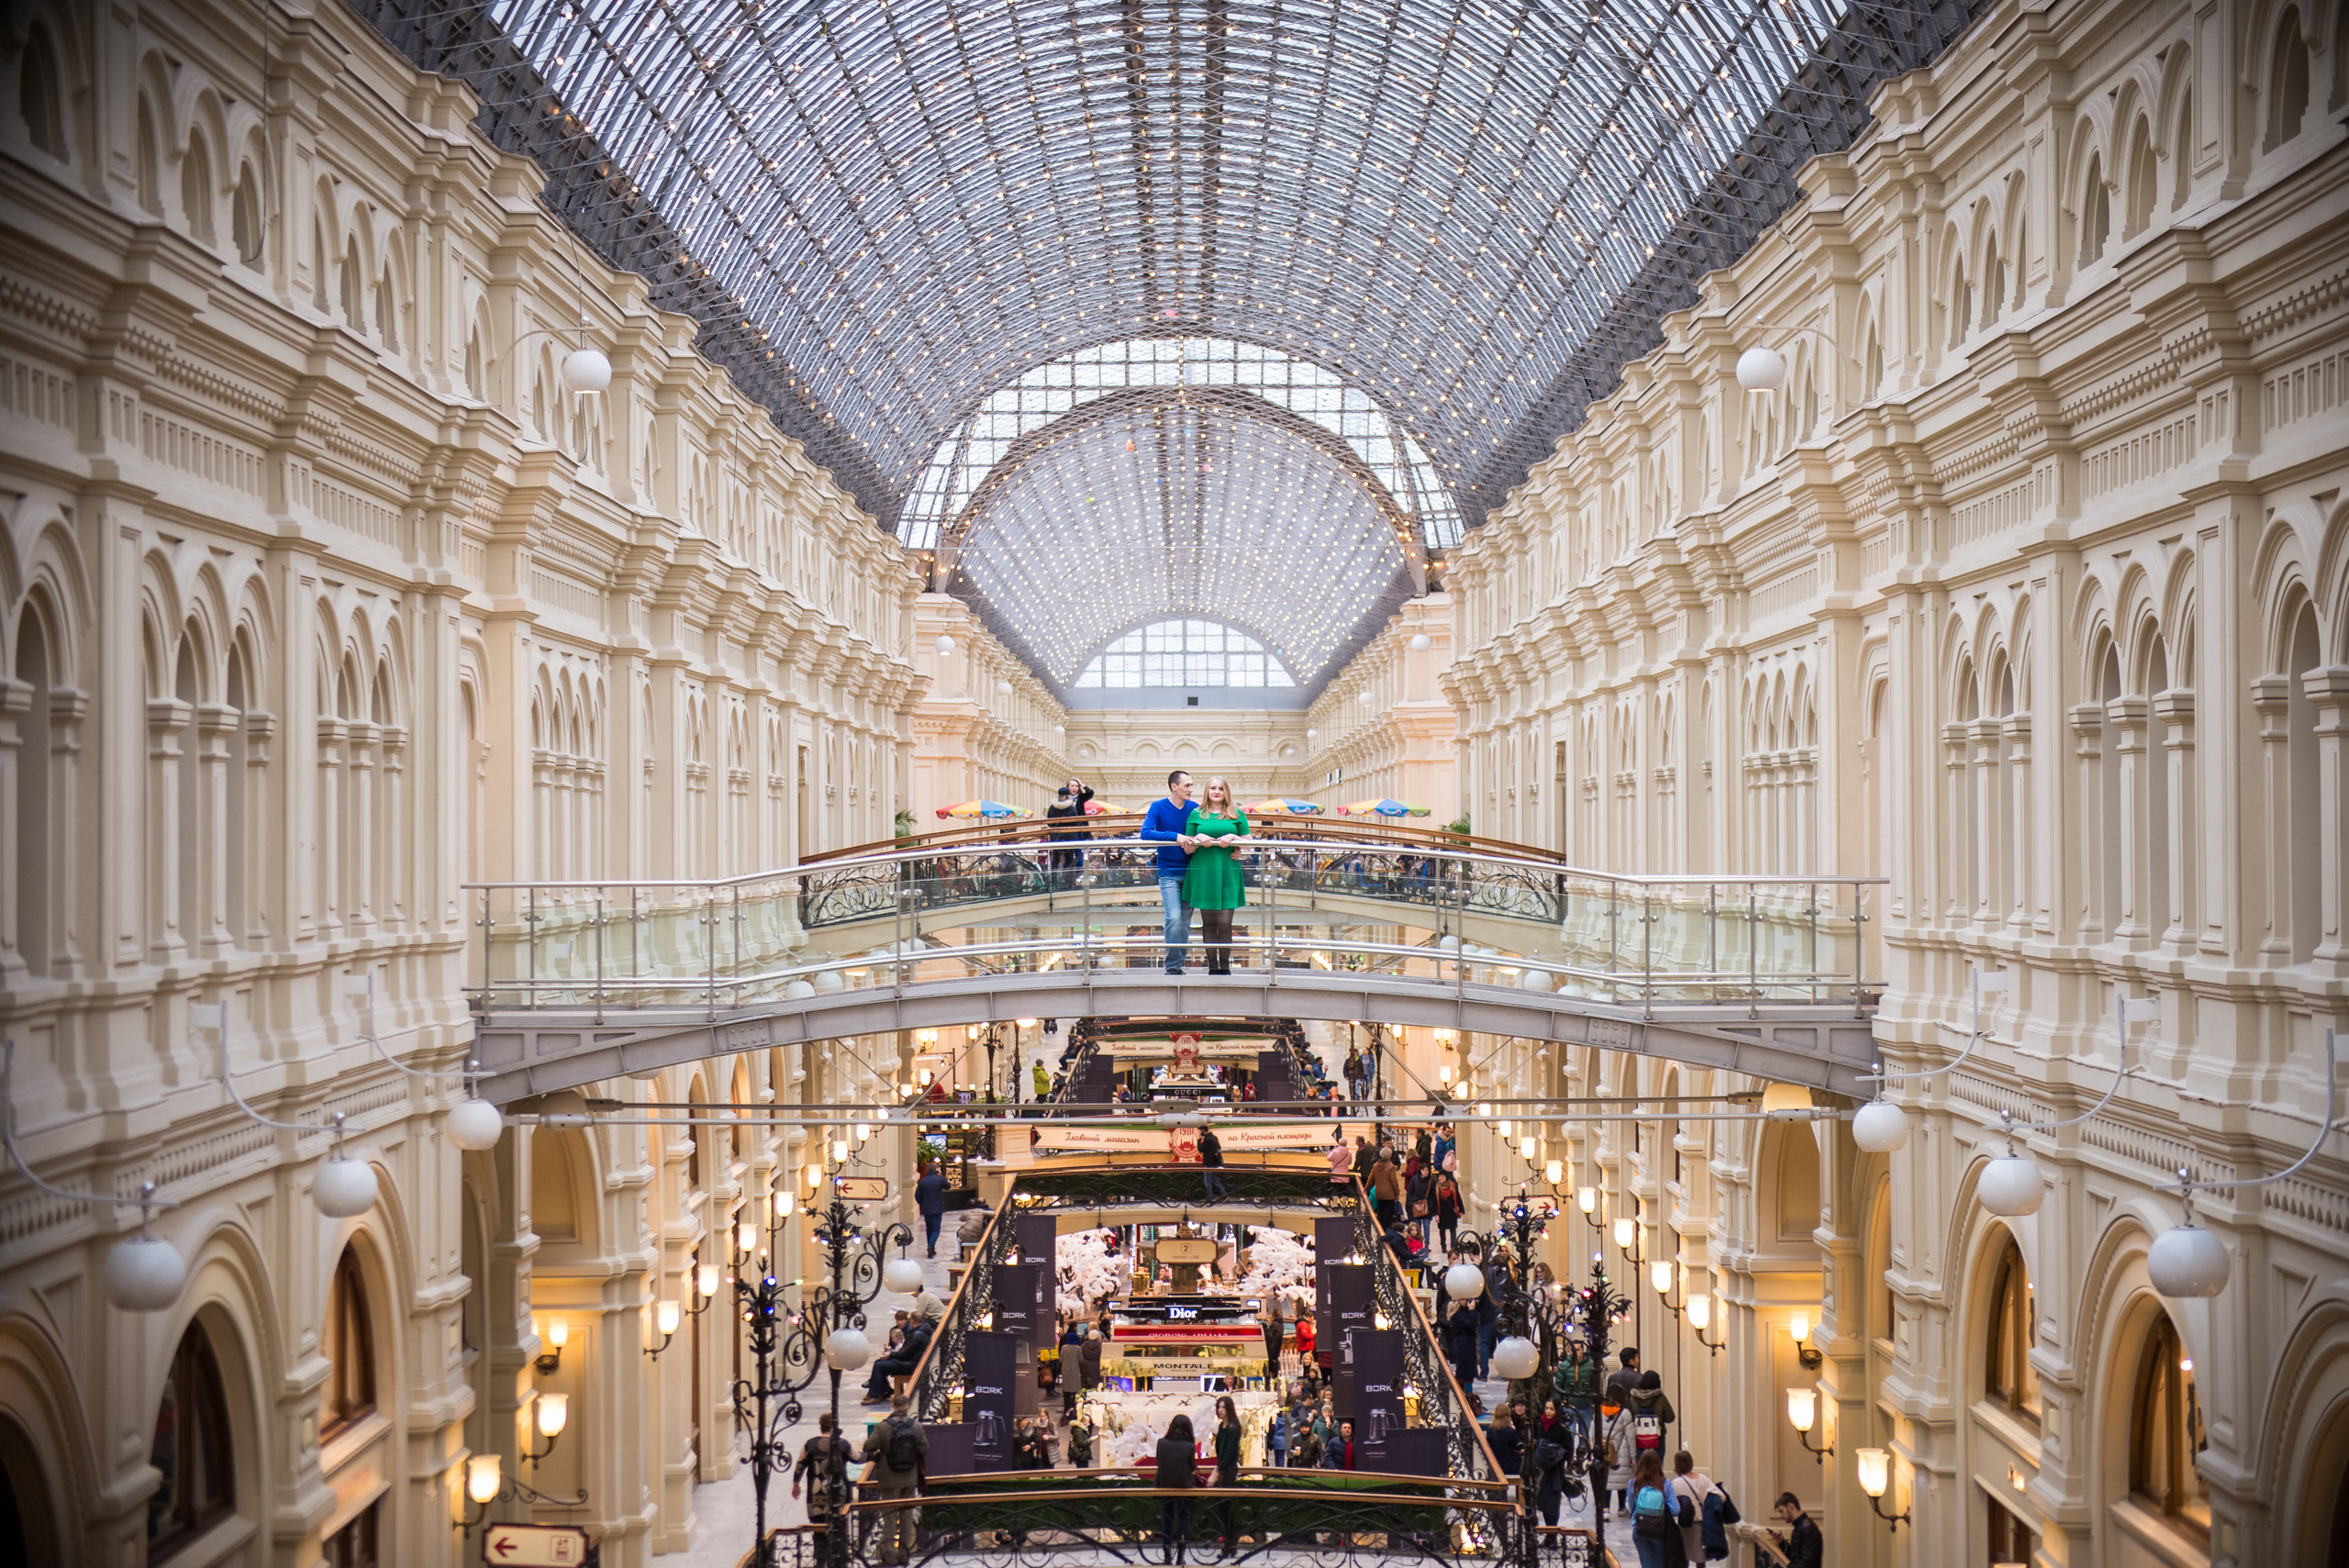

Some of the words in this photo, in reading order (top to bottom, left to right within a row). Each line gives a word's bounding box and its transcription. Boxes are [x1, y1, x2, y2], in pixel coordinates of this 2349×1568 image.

[1064, 1132, 1100, 1142] Главный
[1241, 1131, 1275, 1141] Красной
[1277, 1132, 1312, 1142] площади
[1169, 1307, 1197, 1318] Dior
[975, 1386, 1003, 1395] BORK
[1365, 1385, 1393, 1393] BORK
